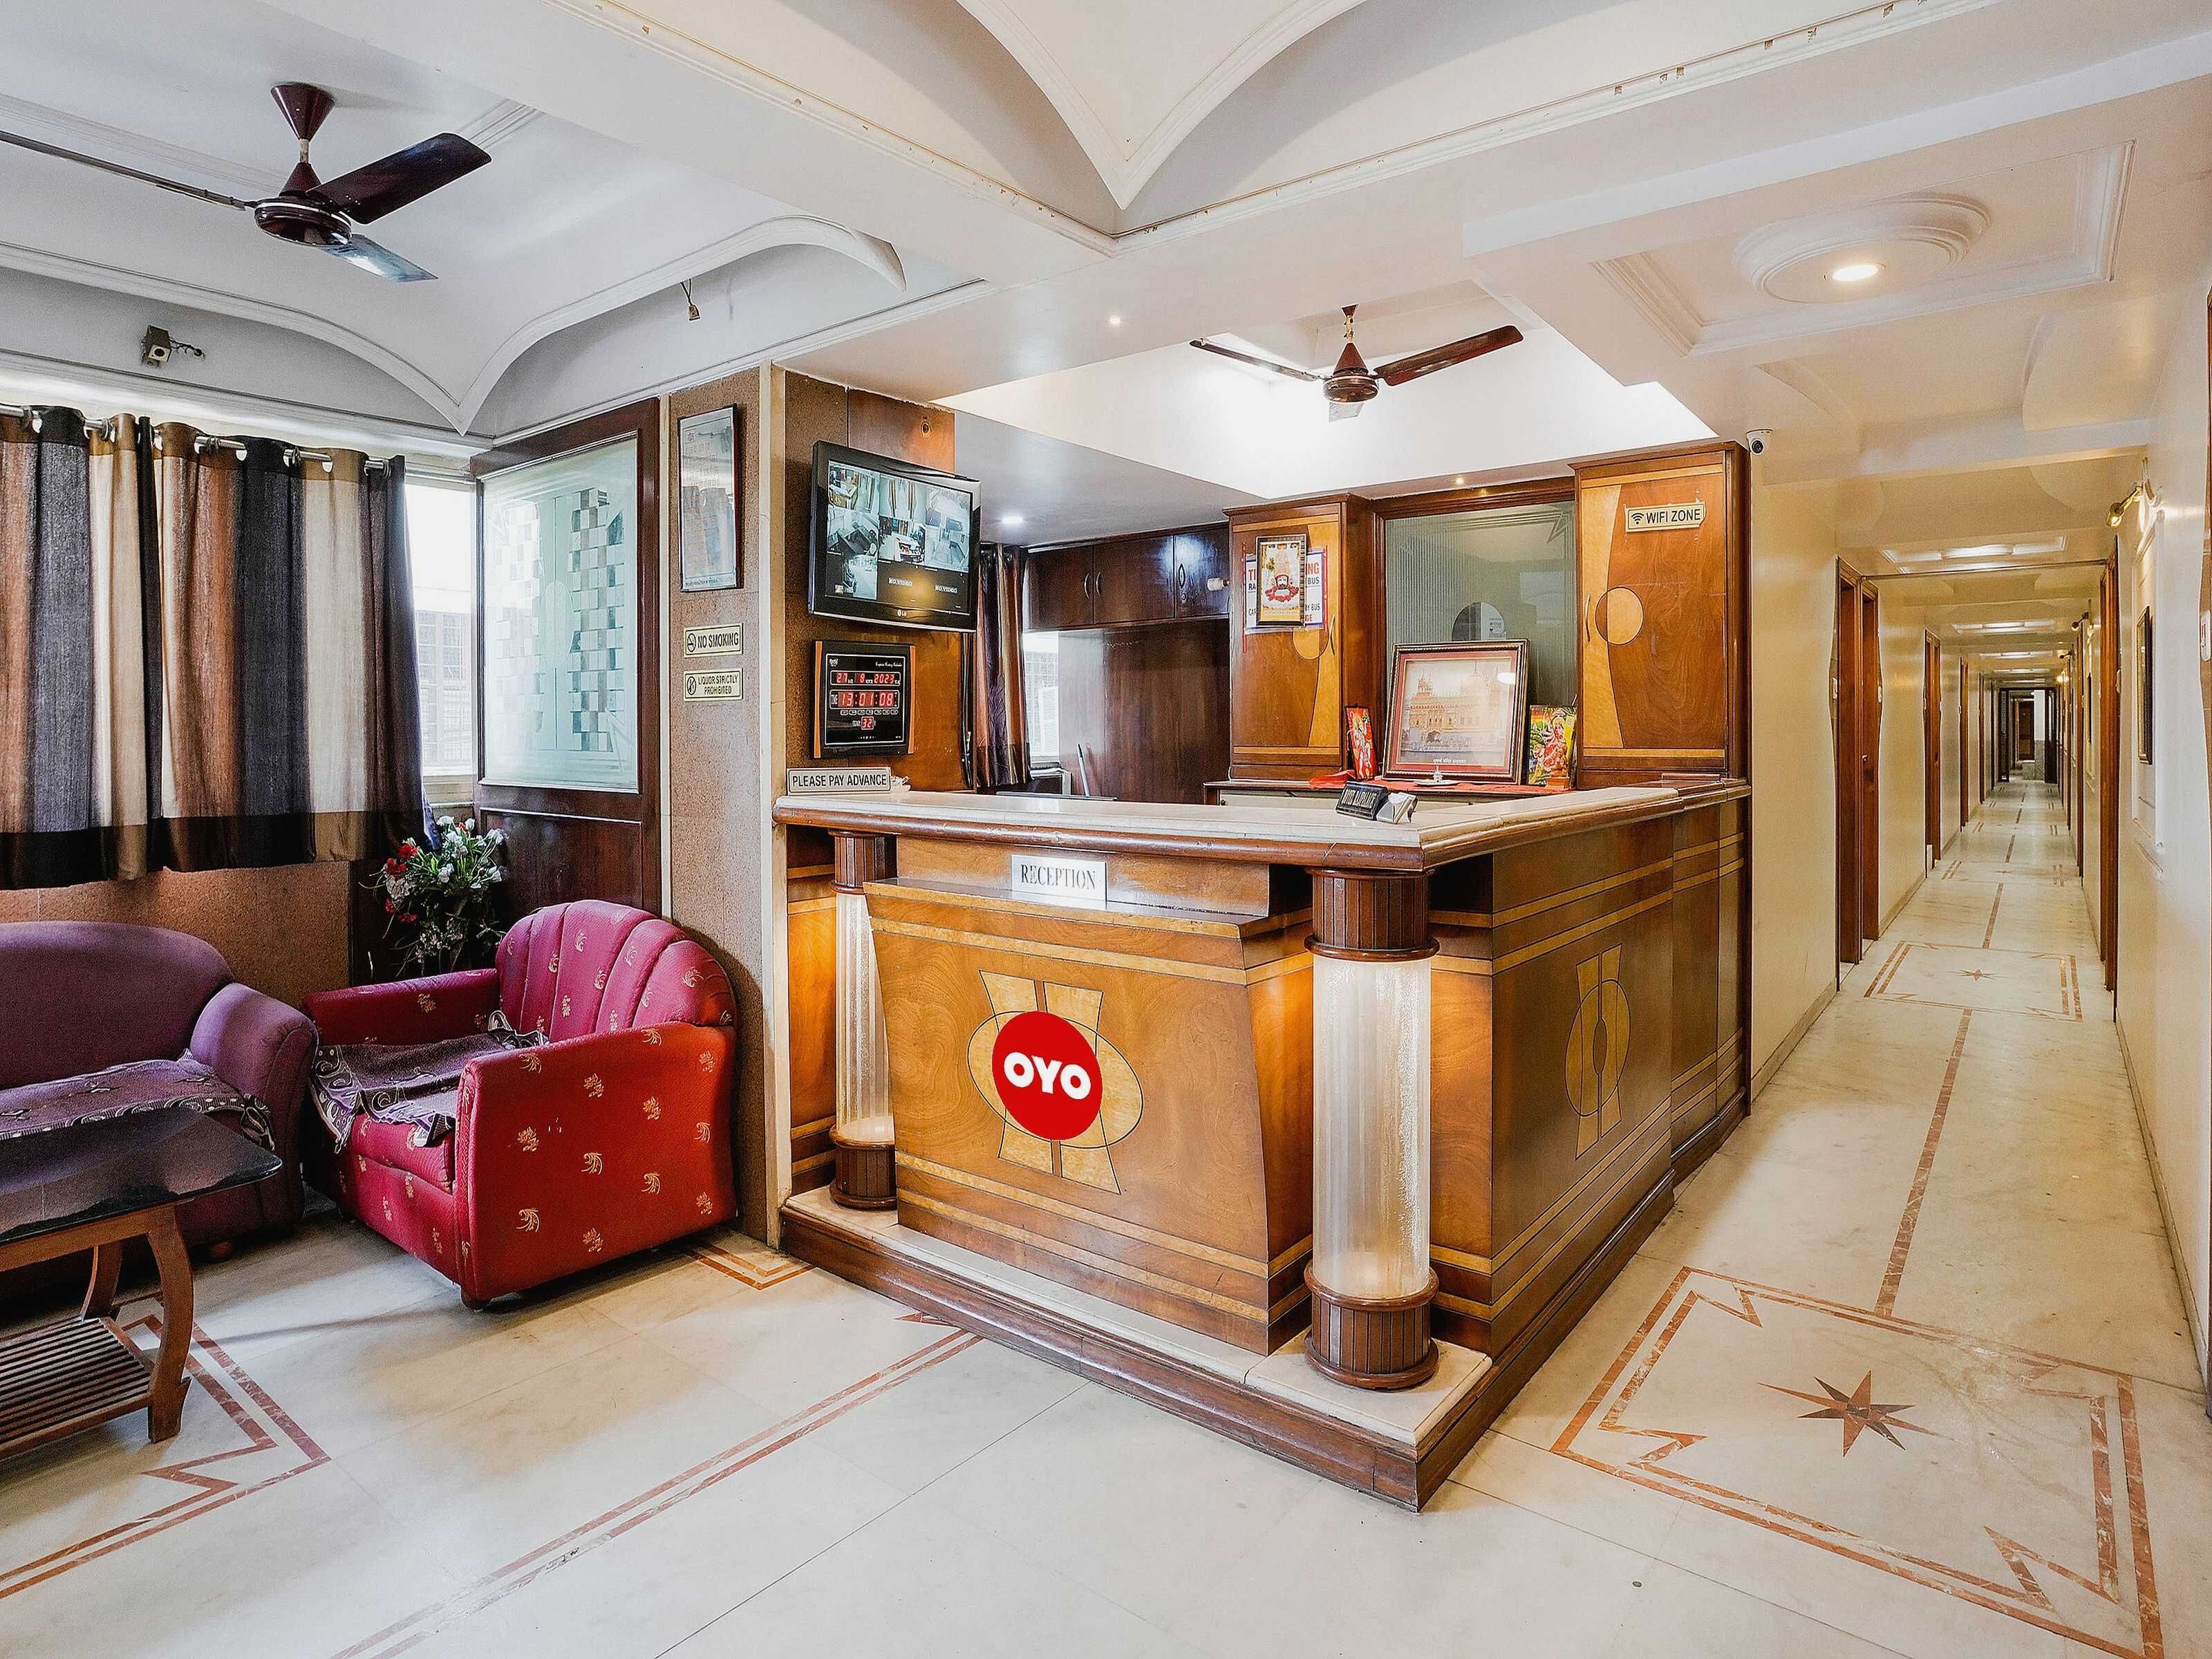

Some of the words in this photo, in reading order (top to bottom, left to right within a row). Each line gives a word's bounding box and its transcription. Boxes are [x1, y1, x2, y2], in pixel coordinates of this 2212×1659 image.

[1647, 512, 1668, 524] WIFI
[1671, 509, 1700, 521] ZONE
[1307, 577, 1320, 585] BUS
[1311, 603, 1320, 611] BUS
[697, 635, 707, 648] NO
[709, 632, 739, 648] SMOKING
[697, 676, 715, 685] LIQUOR
[715, 675, 738, 684] STRICTLY
[836, 673, 848, 683] 27
[874, 673, 895, 684] 2023
[704, 686, 732, 695] PROHIBITED
[863, 719, 872, 728] 32
[792, 775, 826, 787] PLEASE
[830, 775, 845, 786] PAY
[847, 774, 887, 786] ADVANCE
[1020, 864, 1096, 890] RECEPTION
[1004, 1051, 1091, 1100] OYO
